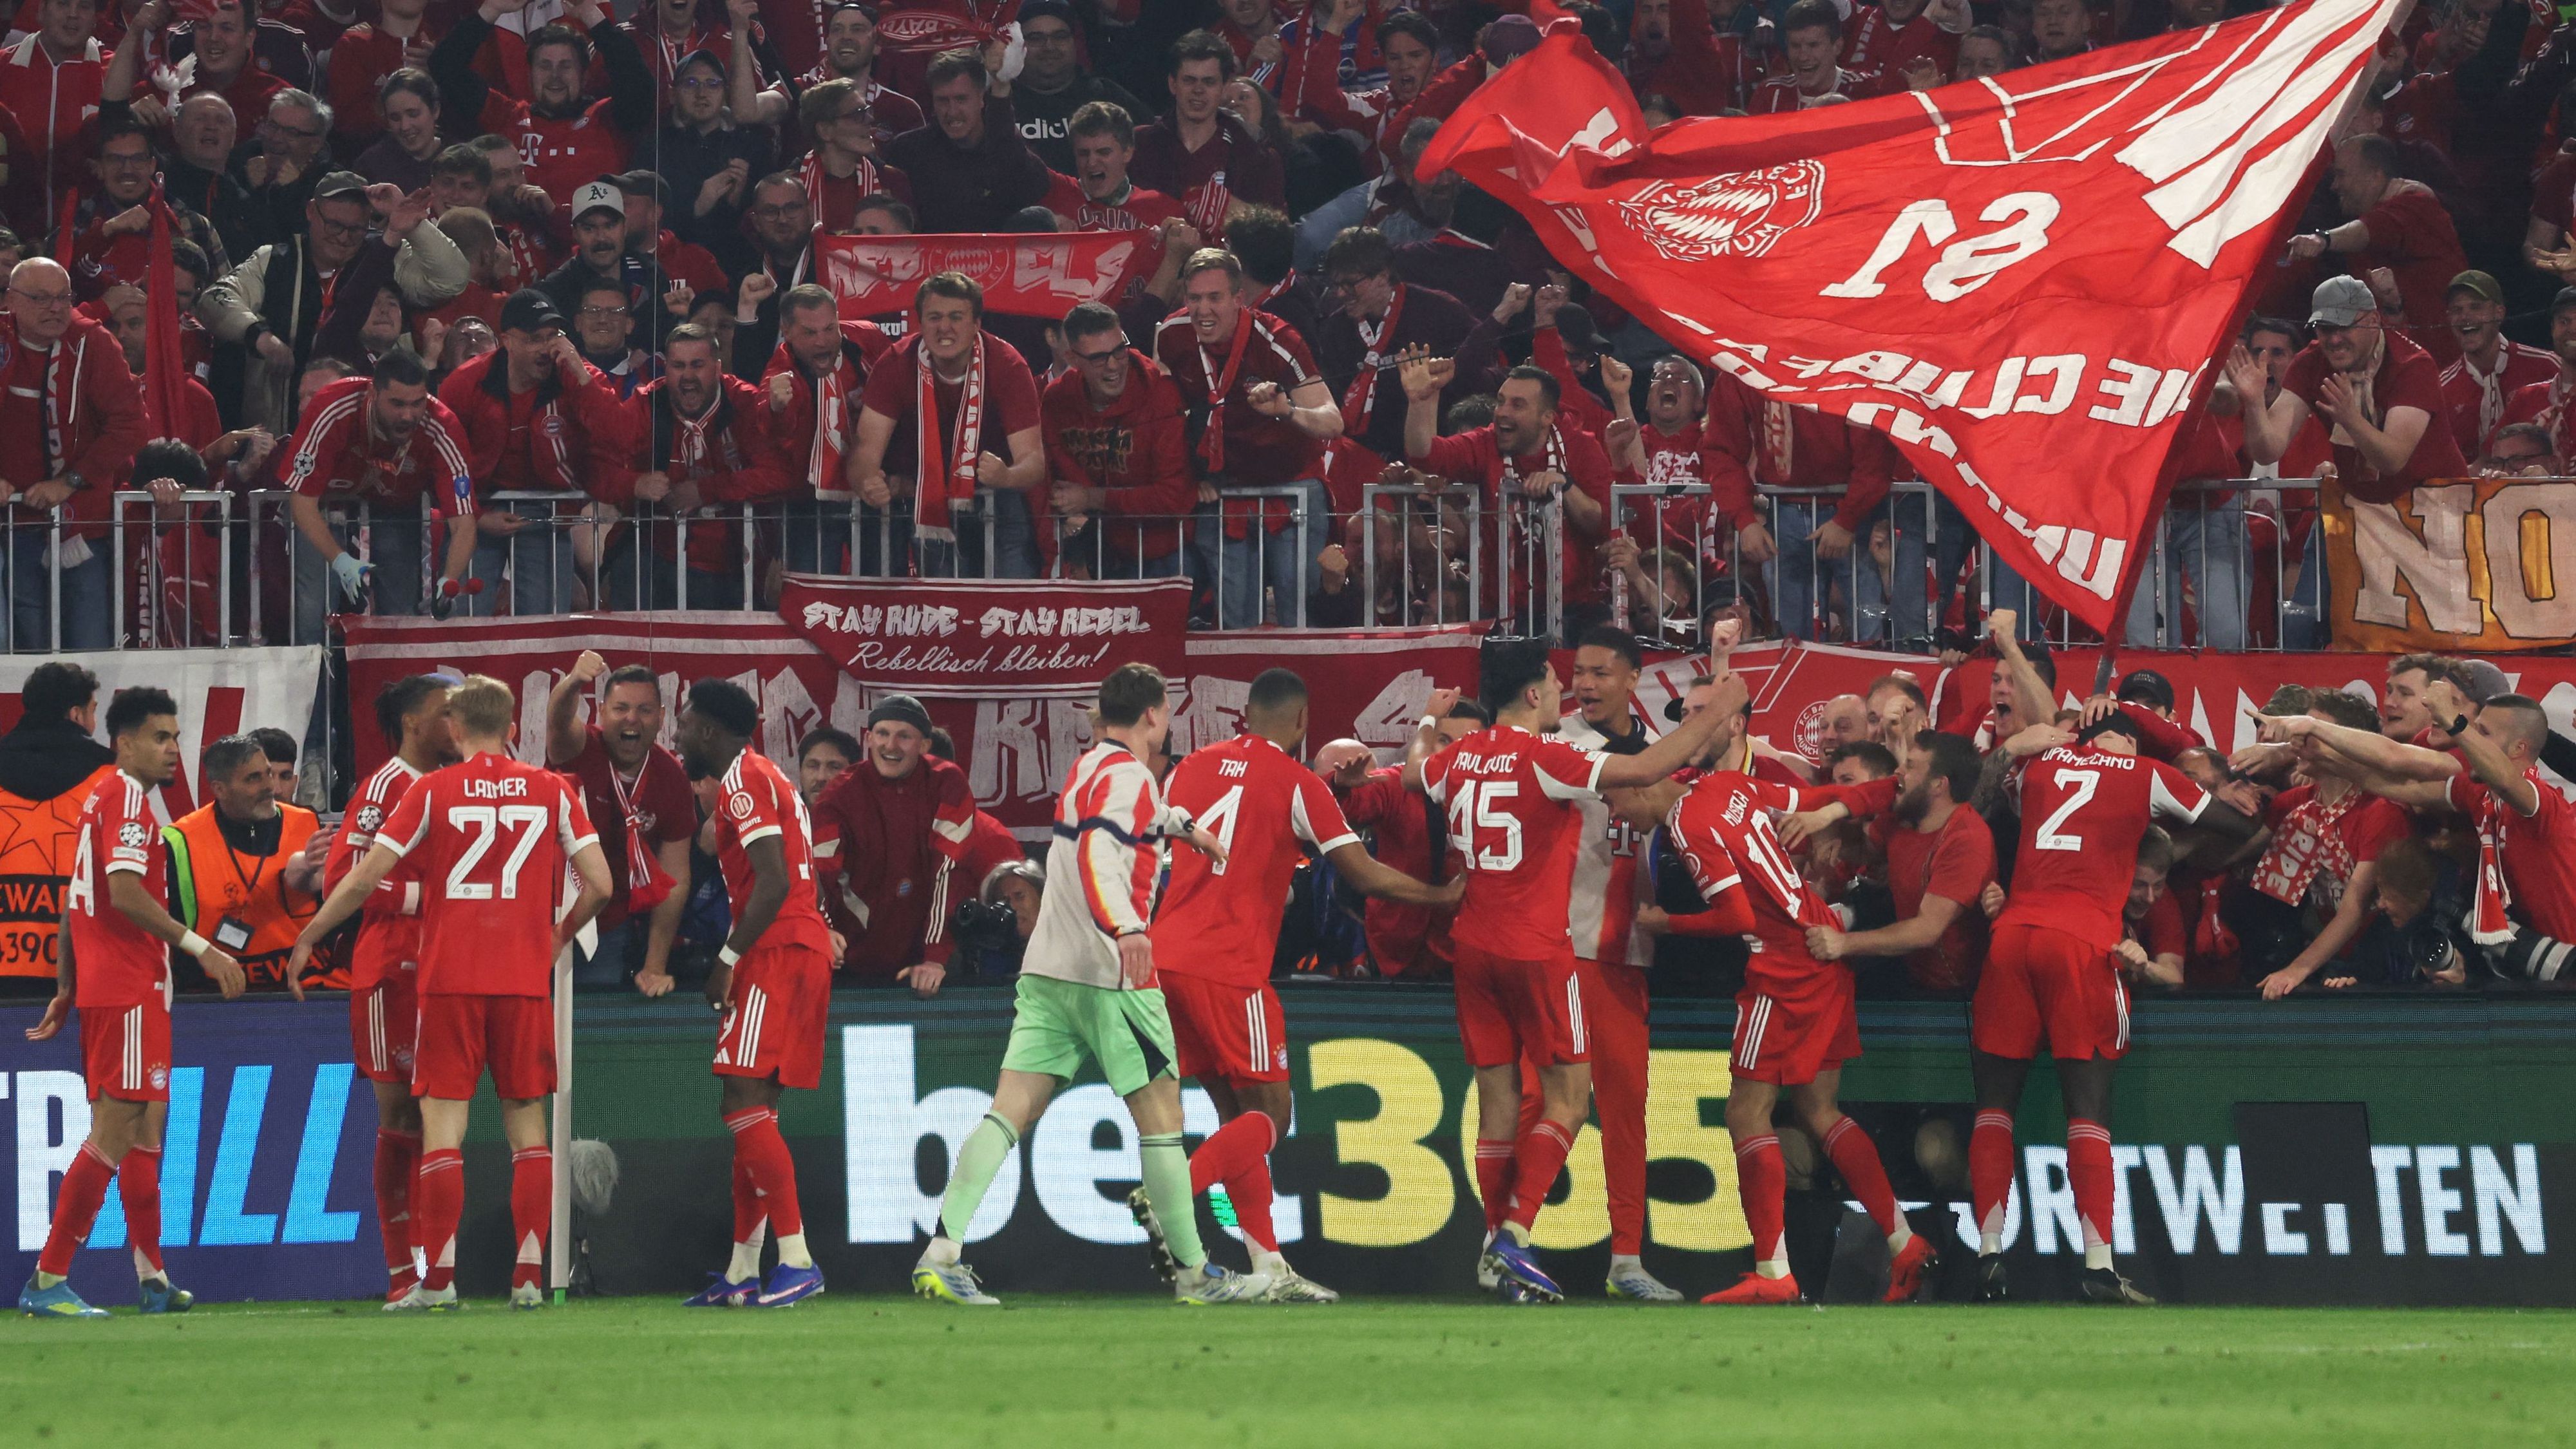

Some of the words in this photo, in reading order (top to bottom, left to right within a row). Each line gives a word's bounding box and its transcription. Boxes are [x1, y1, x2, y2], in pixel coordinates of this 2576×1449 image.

[802, 600, 883, 636] STAY
[884, 603, 959, 638] RUDE
[980, 607, 1060, 638] STAY
[1059, 605, 1151, 637] REBEL
[847, 641, 994, 672] Rebellisch
[993, 641, 1110, 673] bleiben!
[1796, 734, 1819, 755] MÜNCH
[1218, 757, 1249, 779] TAH
[463, 777, 528, 800] LAIMER
[738, 815, 762, 834] Allianz
[1448, 778, 1523, 872] 45
[2035, 768, 2101, 852] 2
[446, 804, 549, 900] 27
[1743, 808, 1803, 920] 10
